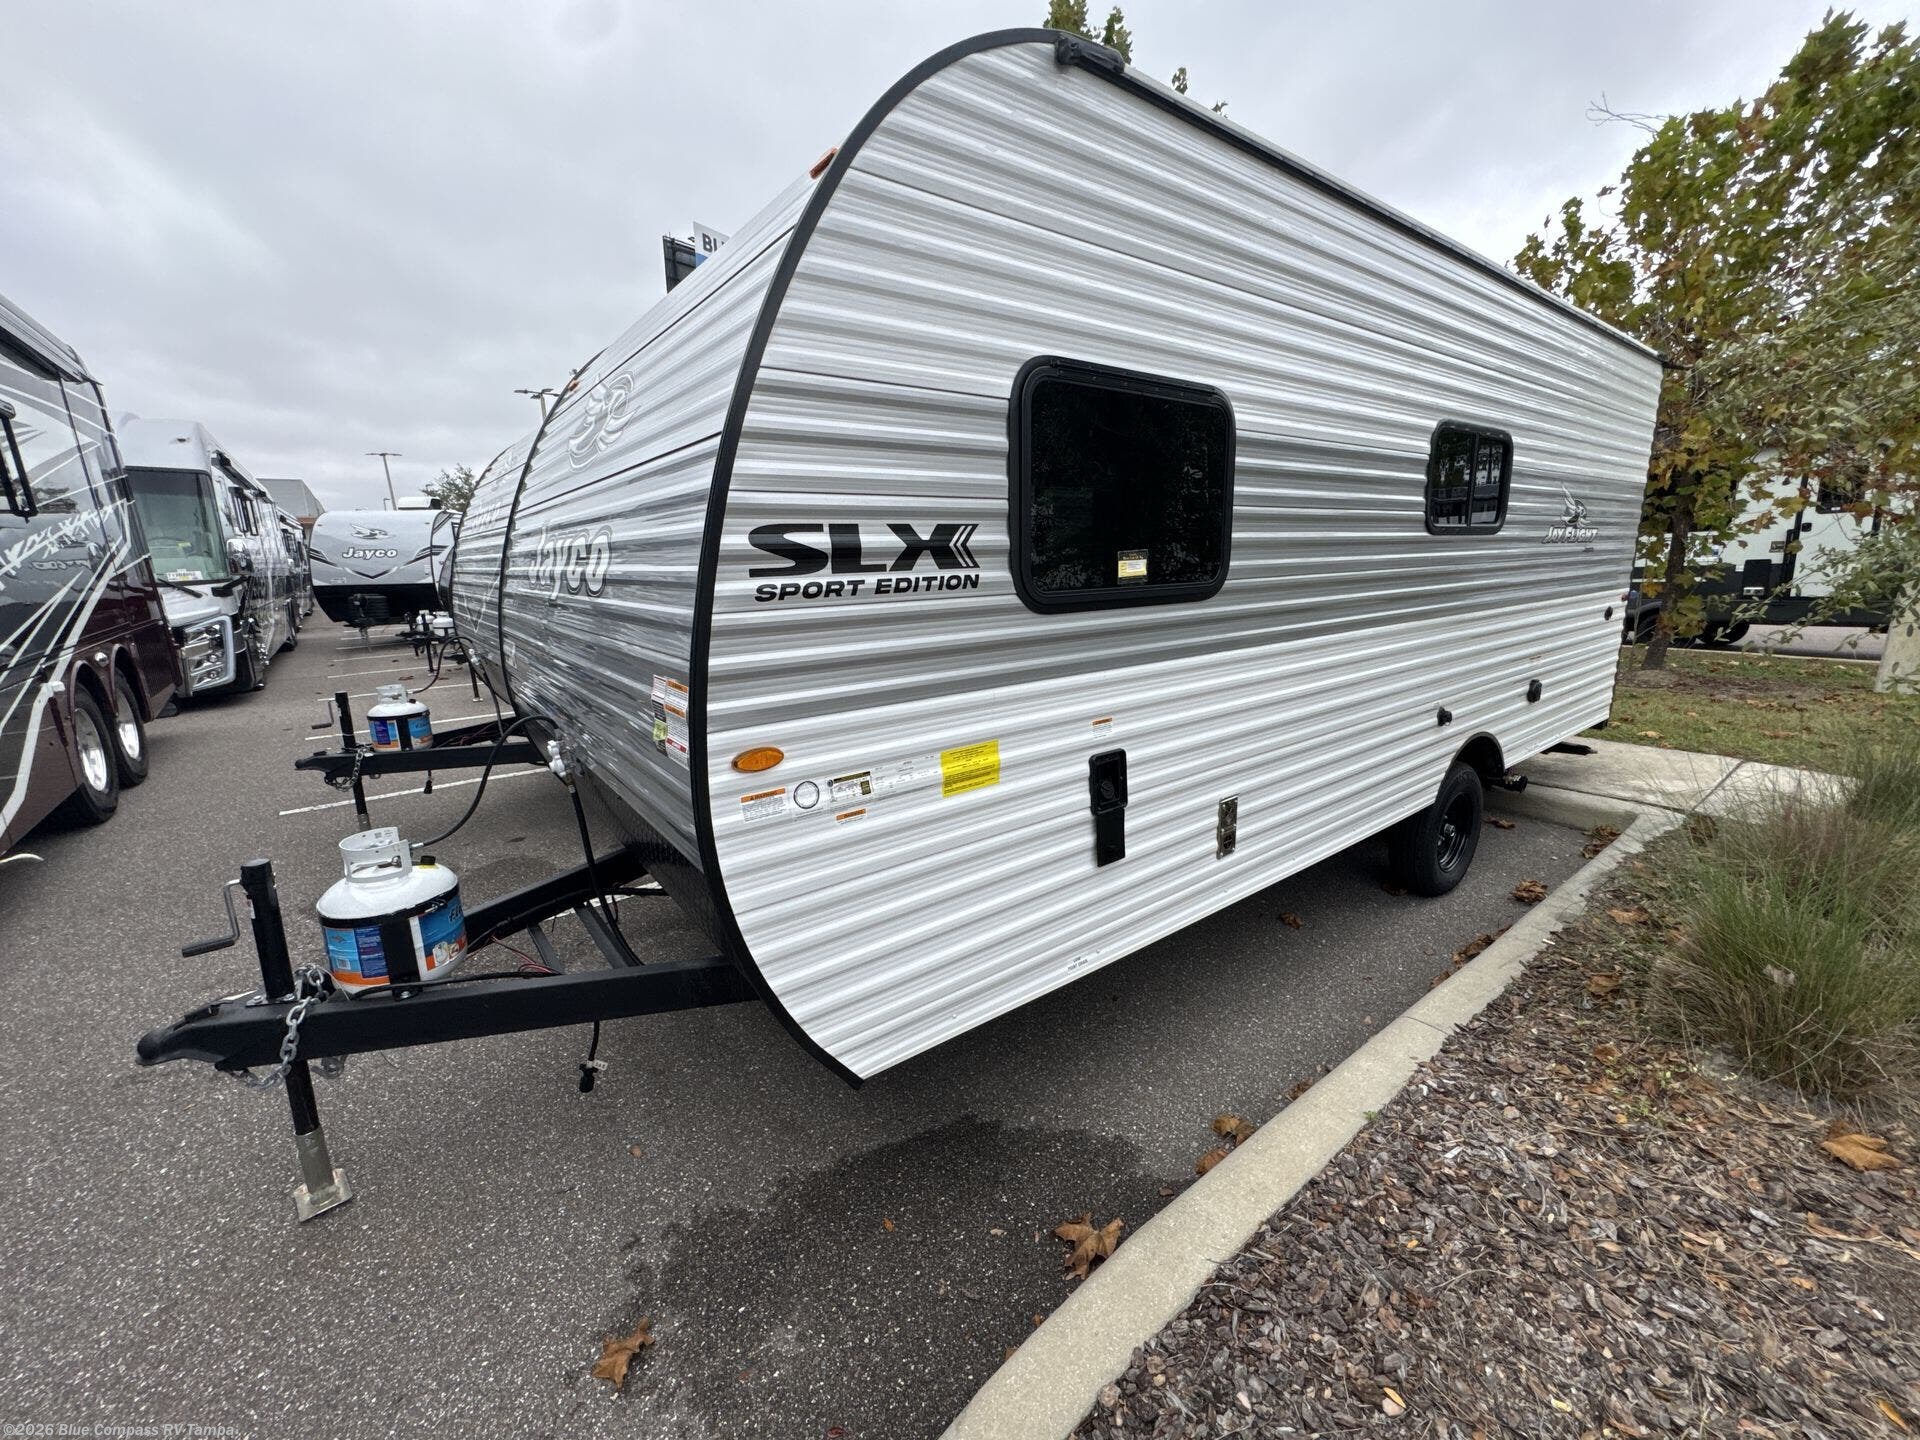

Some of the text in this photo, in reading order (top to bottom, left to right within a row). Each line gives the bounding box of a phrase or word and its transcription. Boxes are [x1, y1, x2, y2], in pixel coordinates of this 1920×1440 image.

[1542, 525, 1599, 543] JAY FLIGHT
[342, 547, 398, 560] Jayco
[527, 525, 613, 602] Jayco
[748, 523, 981, 578] SLX
[754, 574, 981, 602] SPORT EDITION
